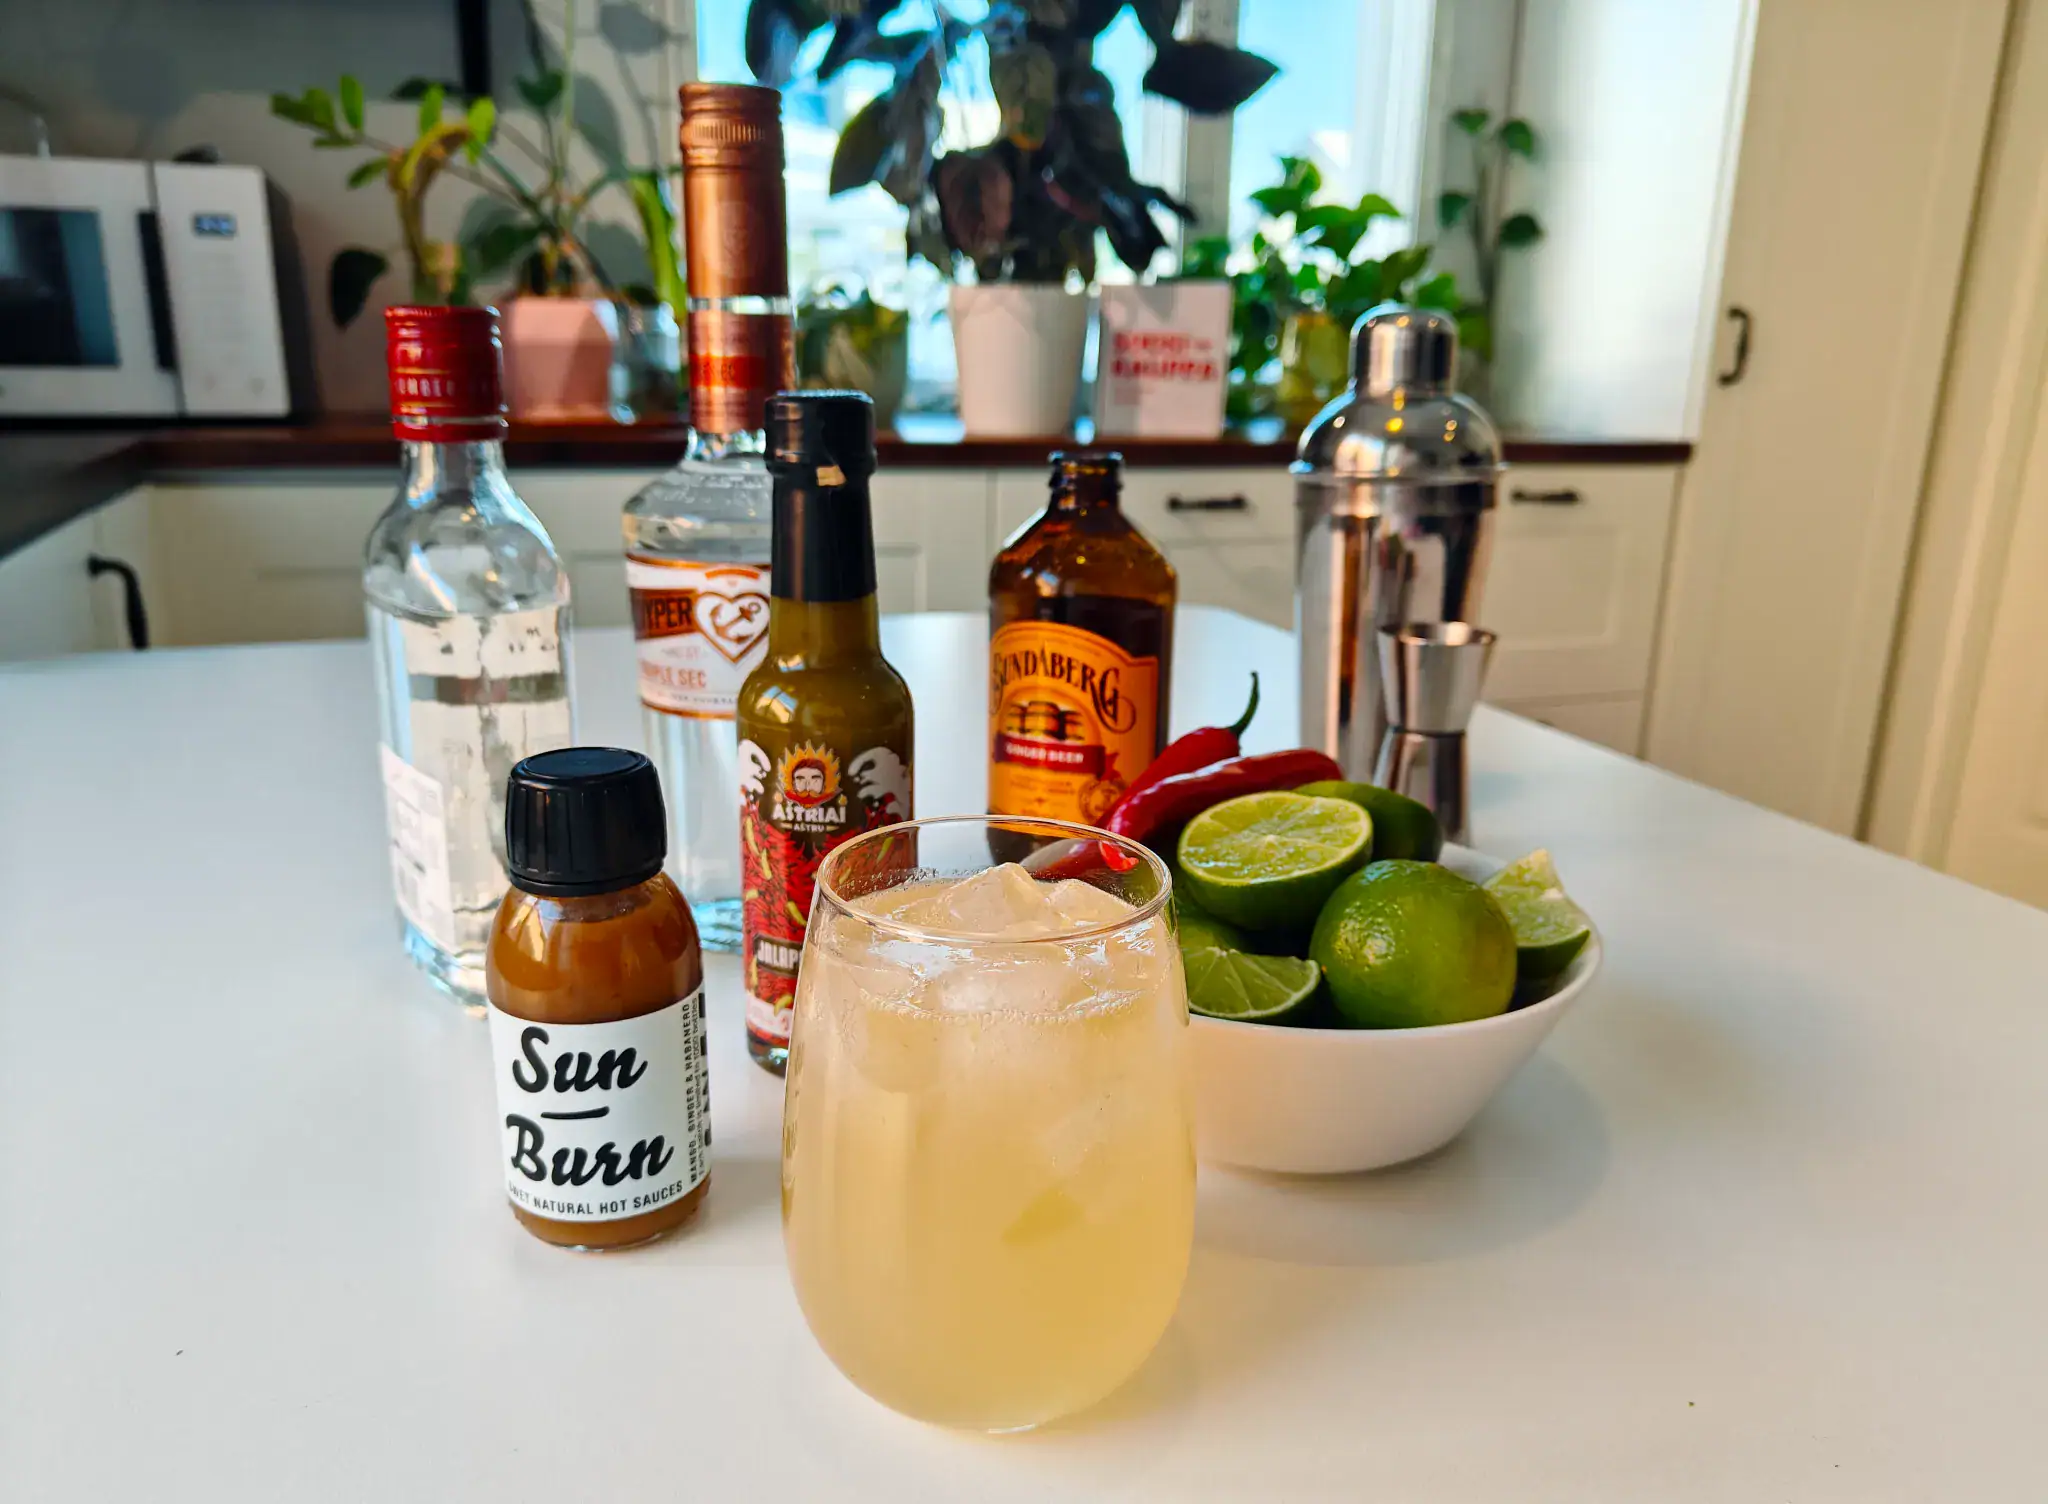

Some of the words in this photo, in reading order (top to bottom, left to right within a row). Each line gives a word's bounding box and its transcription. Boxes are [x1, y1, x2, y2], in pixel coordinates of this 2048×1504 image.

[1047, 750, 1084, 763] BEER
[757, 939, 803, 970] JALAP
[512, 1026, 648, 1093] Sun
[682, 1003, 692, 1071] HABANERO
[506, 1113, 675, 1187] Burn
[533, 1196, 594, 1215] NATURAL
[599, 1199, 628, 1215] HOT
[633, 1180, 683, 1208] SAUCES
